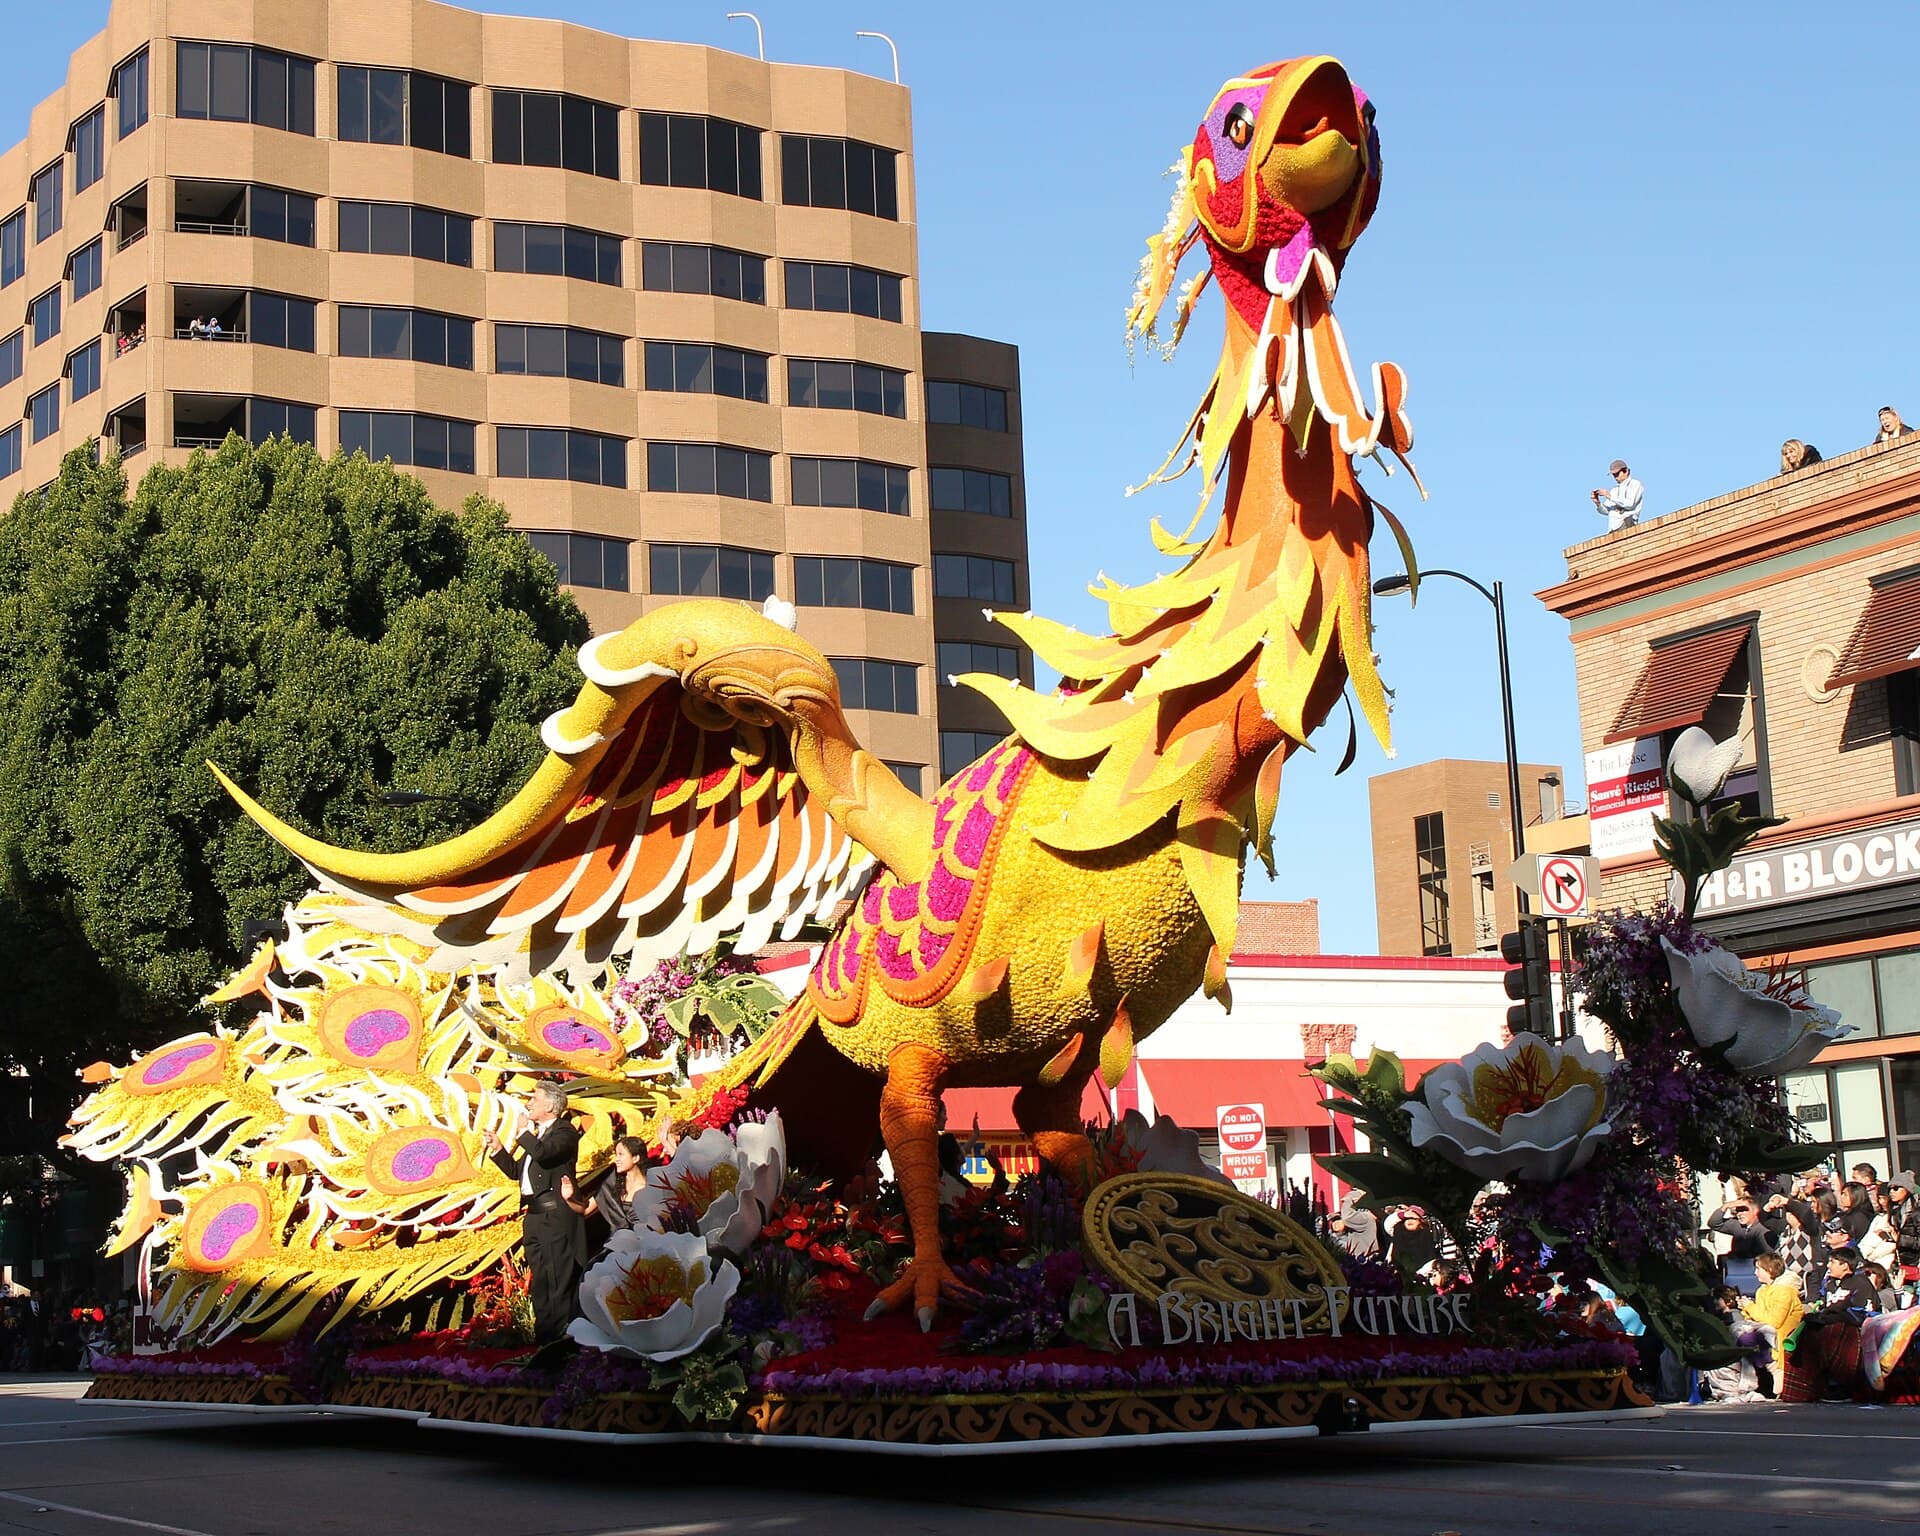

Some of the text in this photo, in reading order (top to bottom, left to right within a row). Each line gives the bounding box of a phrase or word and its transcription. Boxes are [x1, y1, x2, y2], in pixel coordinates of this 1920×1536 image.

[1600, 753, 1647, 772] For Lease
[1623, 777, 1660, 794] Riegel
[1699, 829, 1920, 908] H&R BLOCK
[1225, 1113, 1256, 1123] DO NOT
[1799, 1104, 1824, 1120] OPEN
[1228, 1134, 1255, 1143] ENTER
[1226, 1155, 1262, 1166] WRONG
[1234, 1167, 1255, 1176] WAY
[1106, 1293, 1142, 1350] A
